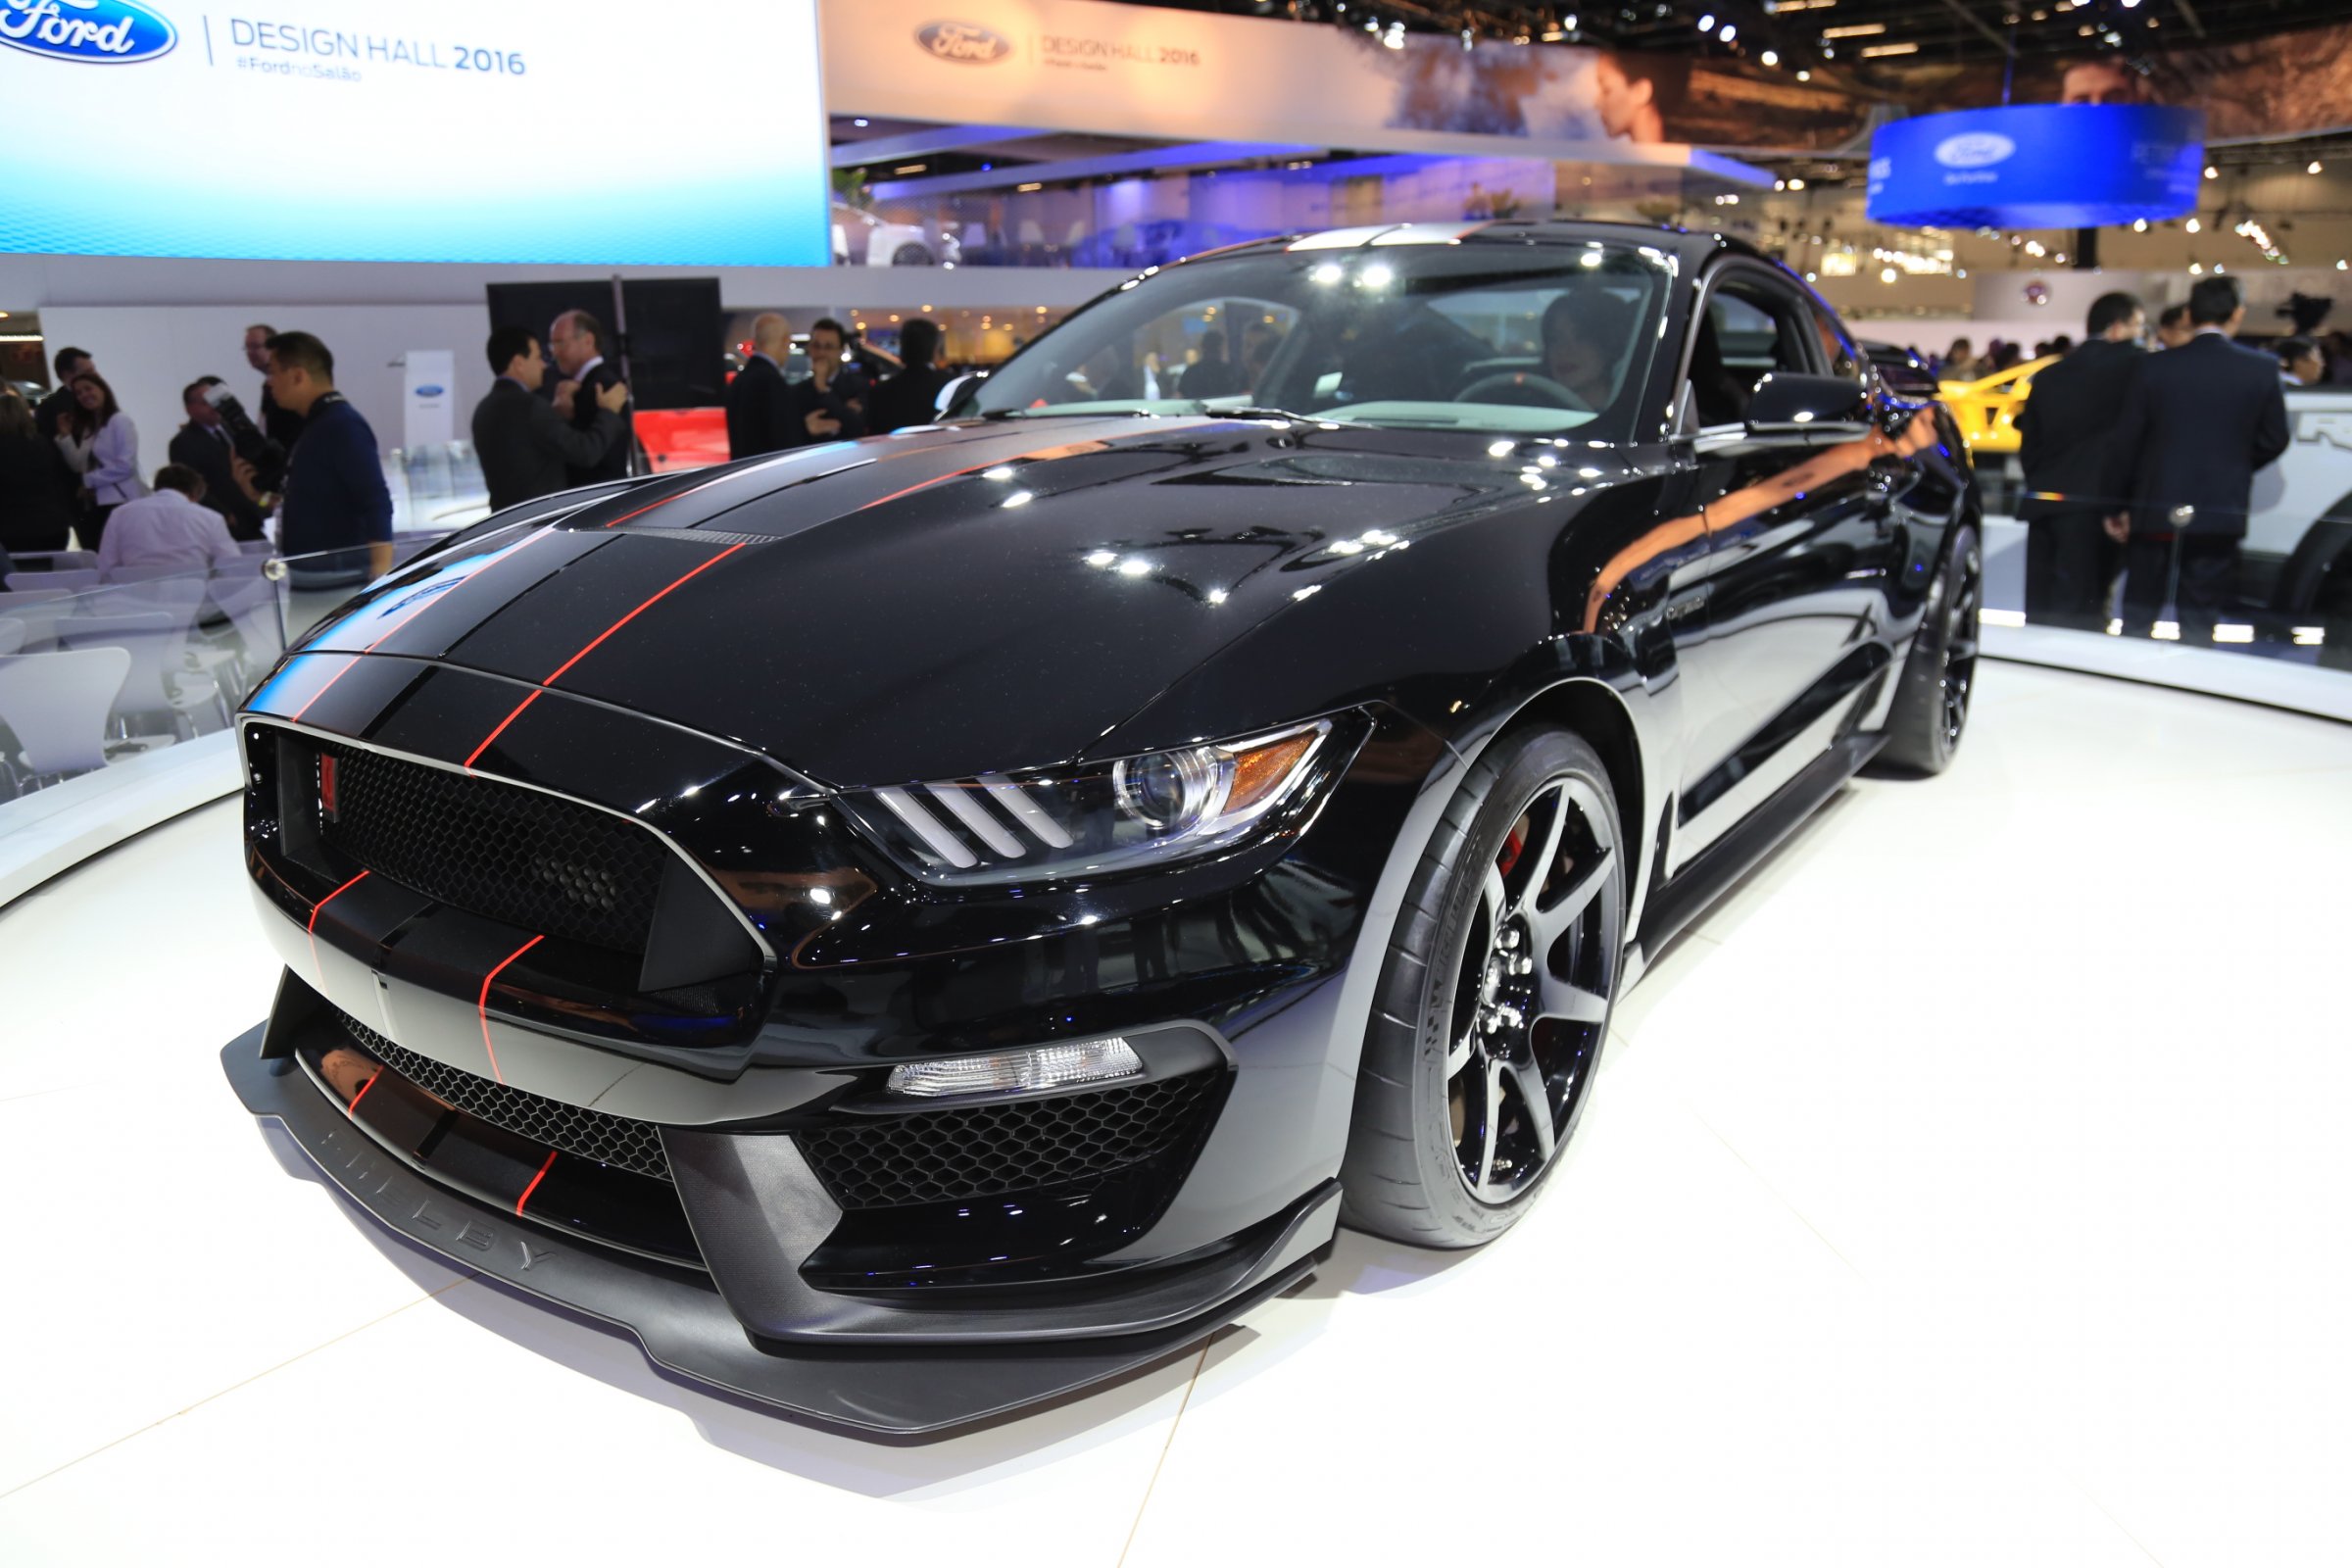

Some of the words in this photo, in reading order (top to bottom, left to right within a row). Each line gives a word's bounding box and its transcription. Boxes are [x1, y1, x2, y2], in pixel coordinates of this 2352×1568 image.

[0, 0, 135, 54] Ford
[230, 18, 359, 58] DESIGN
[367, 34, 448, 69] HALL
[453, 45, 526, 75] 2016
[932, 23, 997, 59] Ford
[1043, 34, 1108, 57] DESIGN
[1157, 46, 1200, 66] 2016
